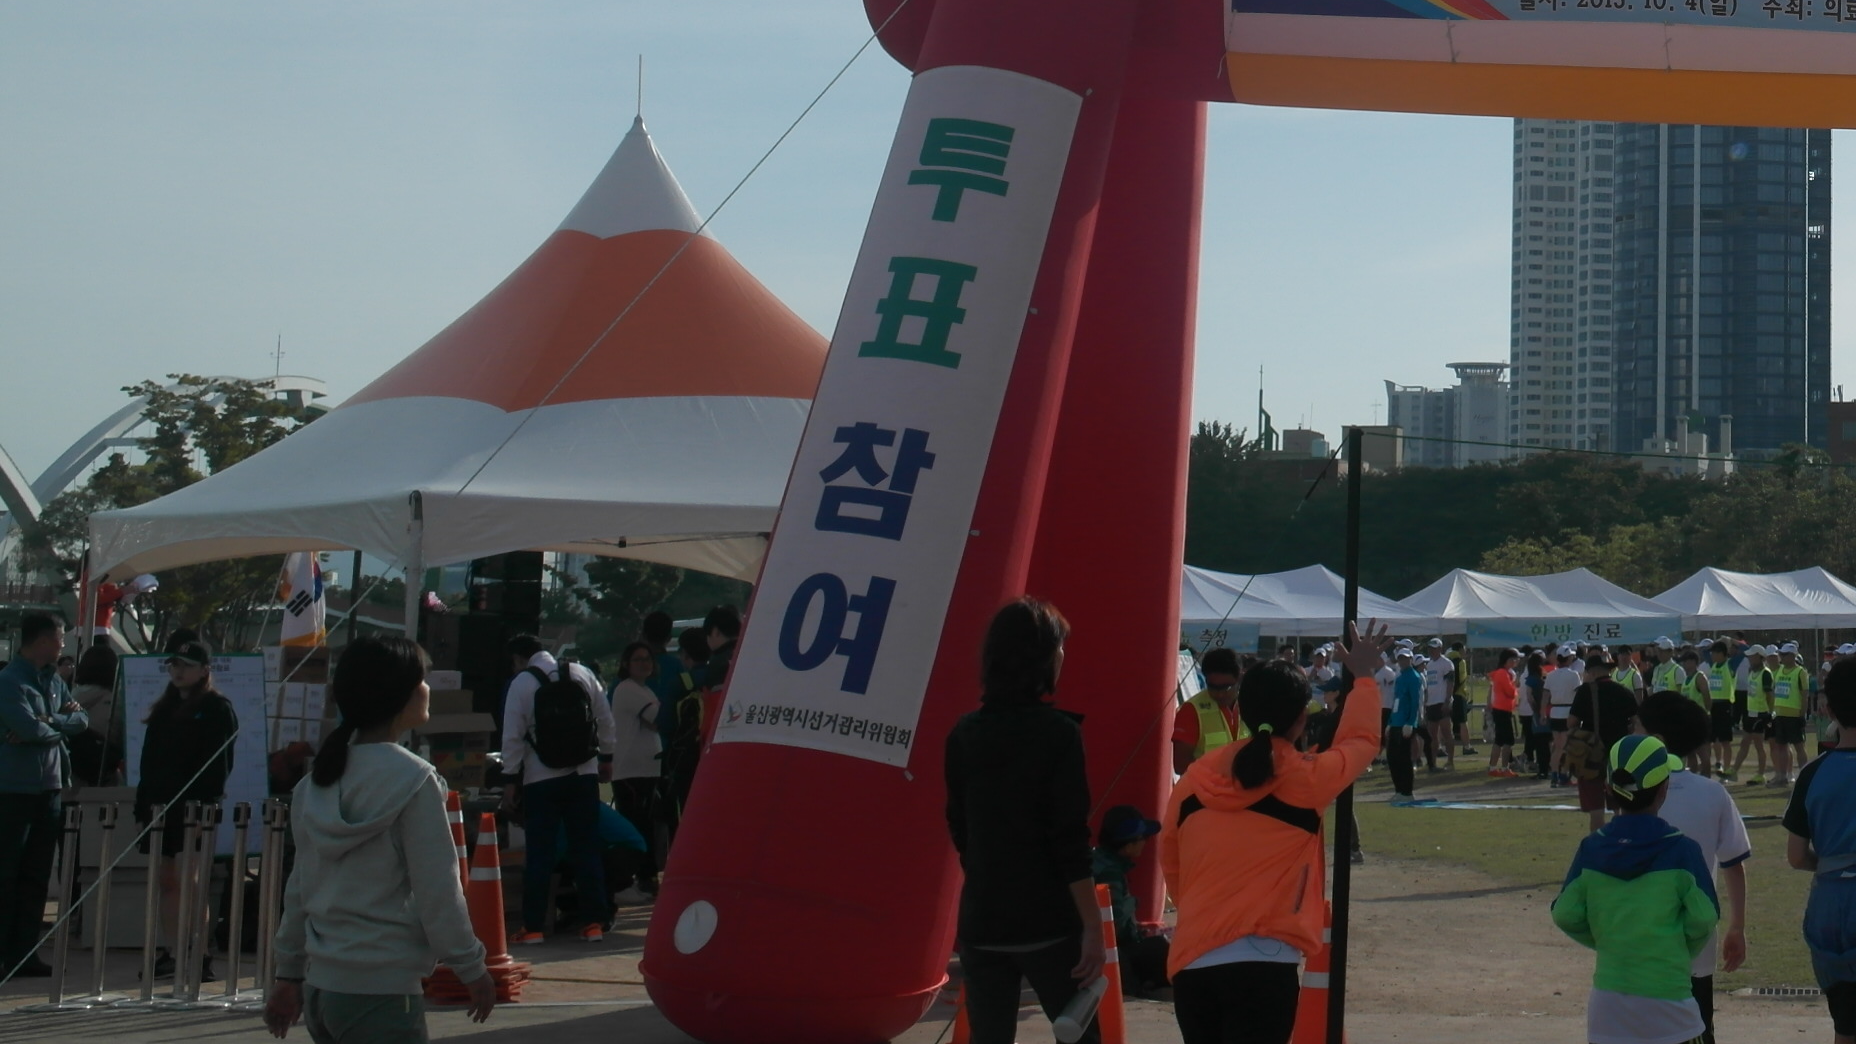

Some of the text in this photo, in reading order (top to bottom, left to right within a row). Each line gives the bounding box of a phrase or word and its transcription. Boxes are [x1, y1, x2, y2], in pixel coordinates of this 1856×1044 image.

[777, 117, 1015, 695] 투표 참여
[1530, 622, 1622, 642] 한방 진료
[745, 704, 912, 749] 울산광역시선거관리위원회
